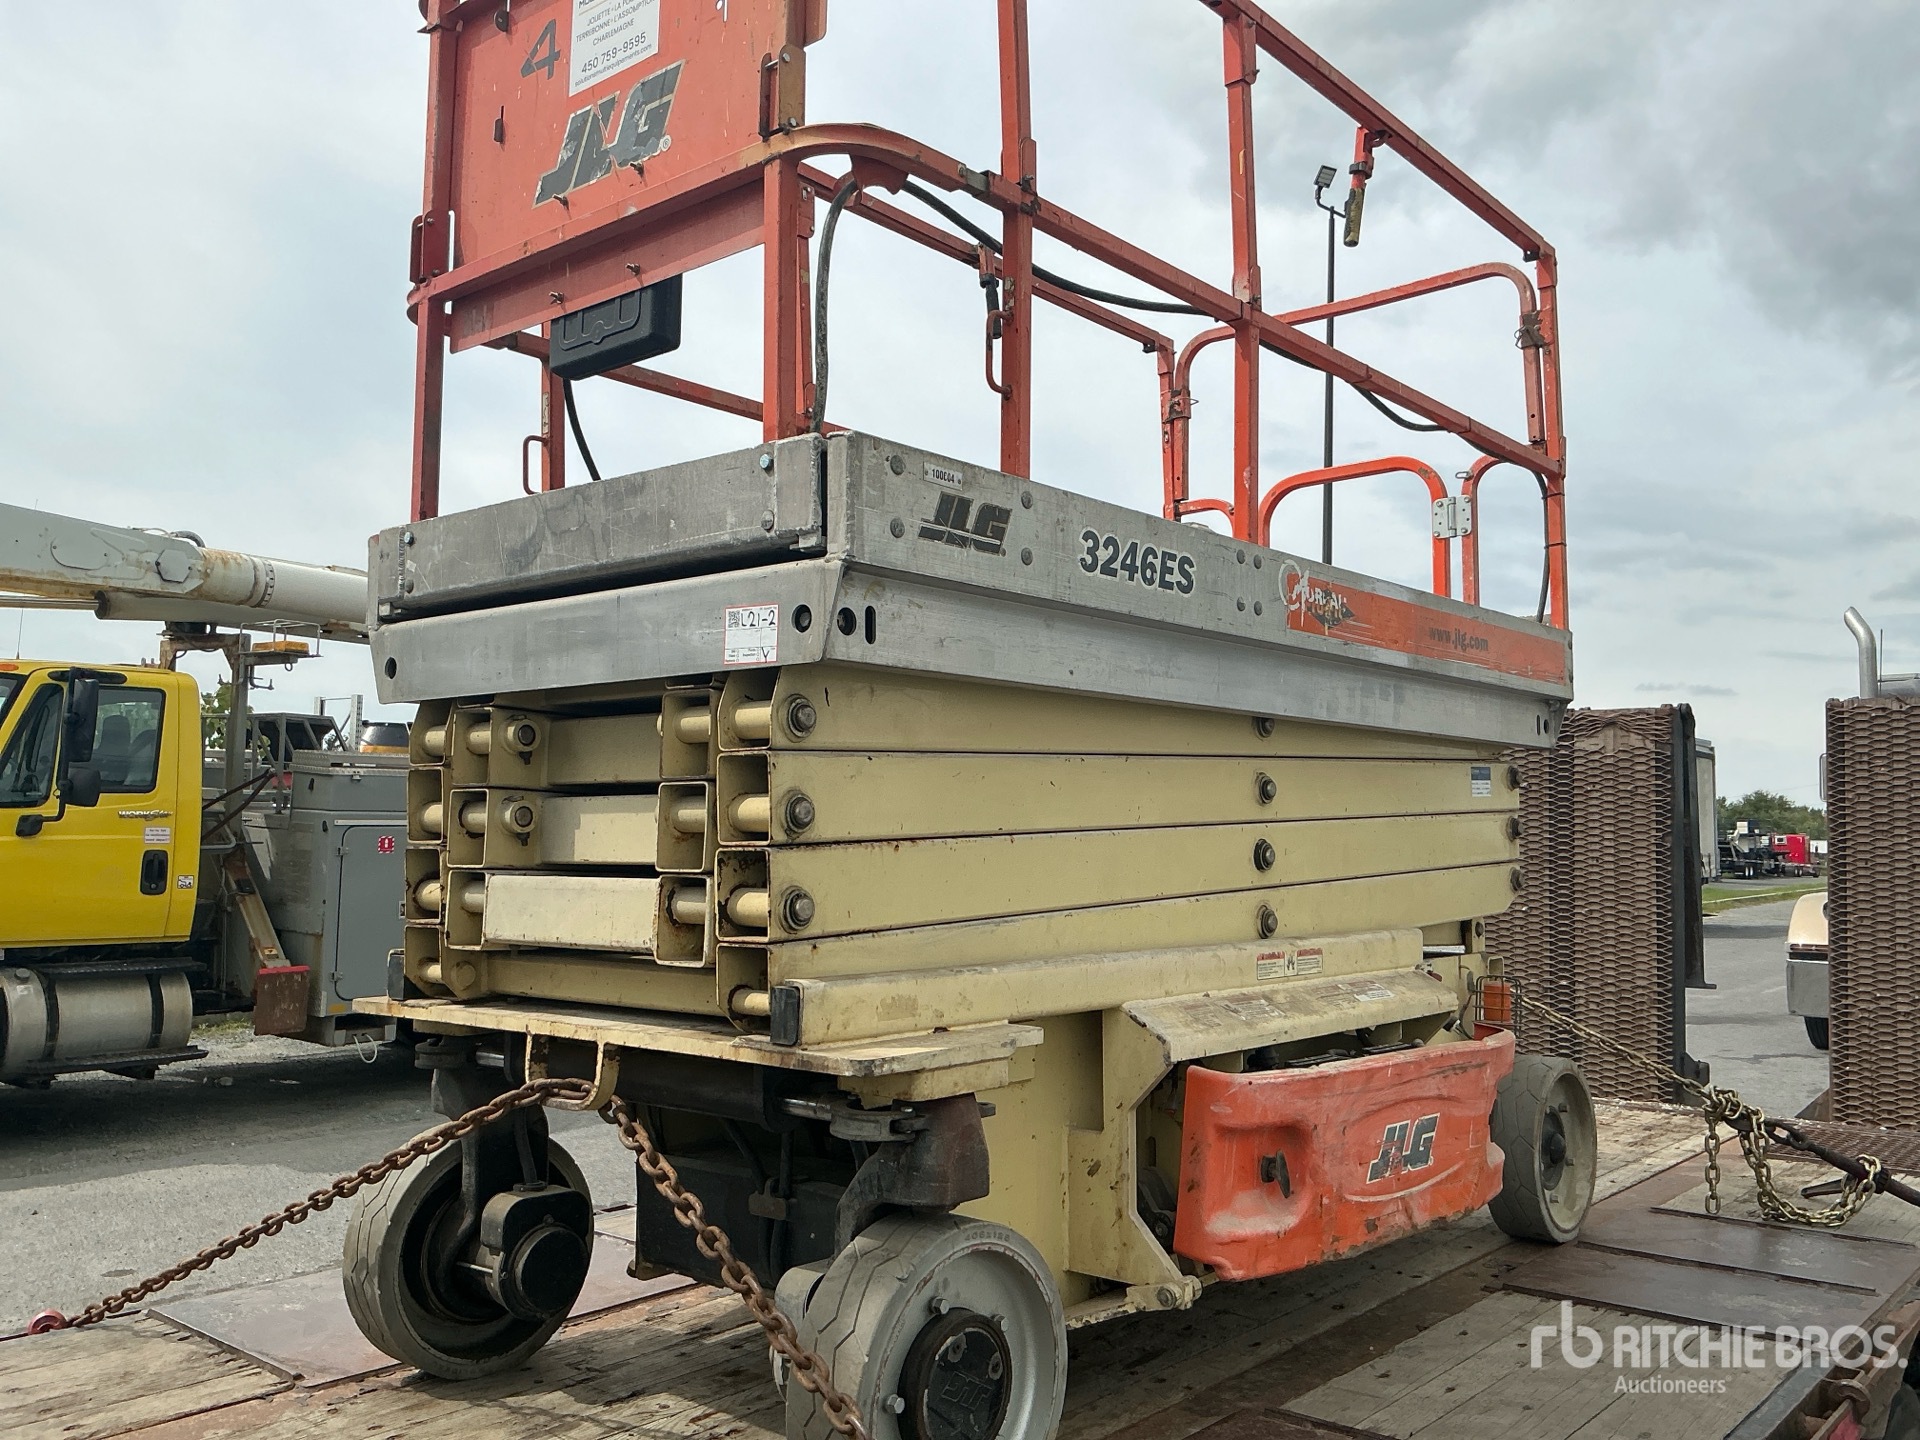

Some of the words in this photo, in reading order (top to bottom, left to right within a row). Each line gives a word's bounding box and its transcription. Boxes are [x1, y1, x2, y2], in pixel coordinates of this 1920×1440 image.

[520, 19, 561, 80] 4
[576, 20, 611, 43] TERREBONNE
[592, 18, 635, 46] CHARLEMAGNE
[581, 56, 599, 74] 450
[601, 32, 646, 65] 759-9595
[918, 491, 1013, 556] JLG
[1079, 529, 1196, 596] 3246ES
[740, 609, 776, 628] L21-2
[1428, 627, 1489, 652] www.jlg.com
[1366, 1112, 1441, 1184] JLG
